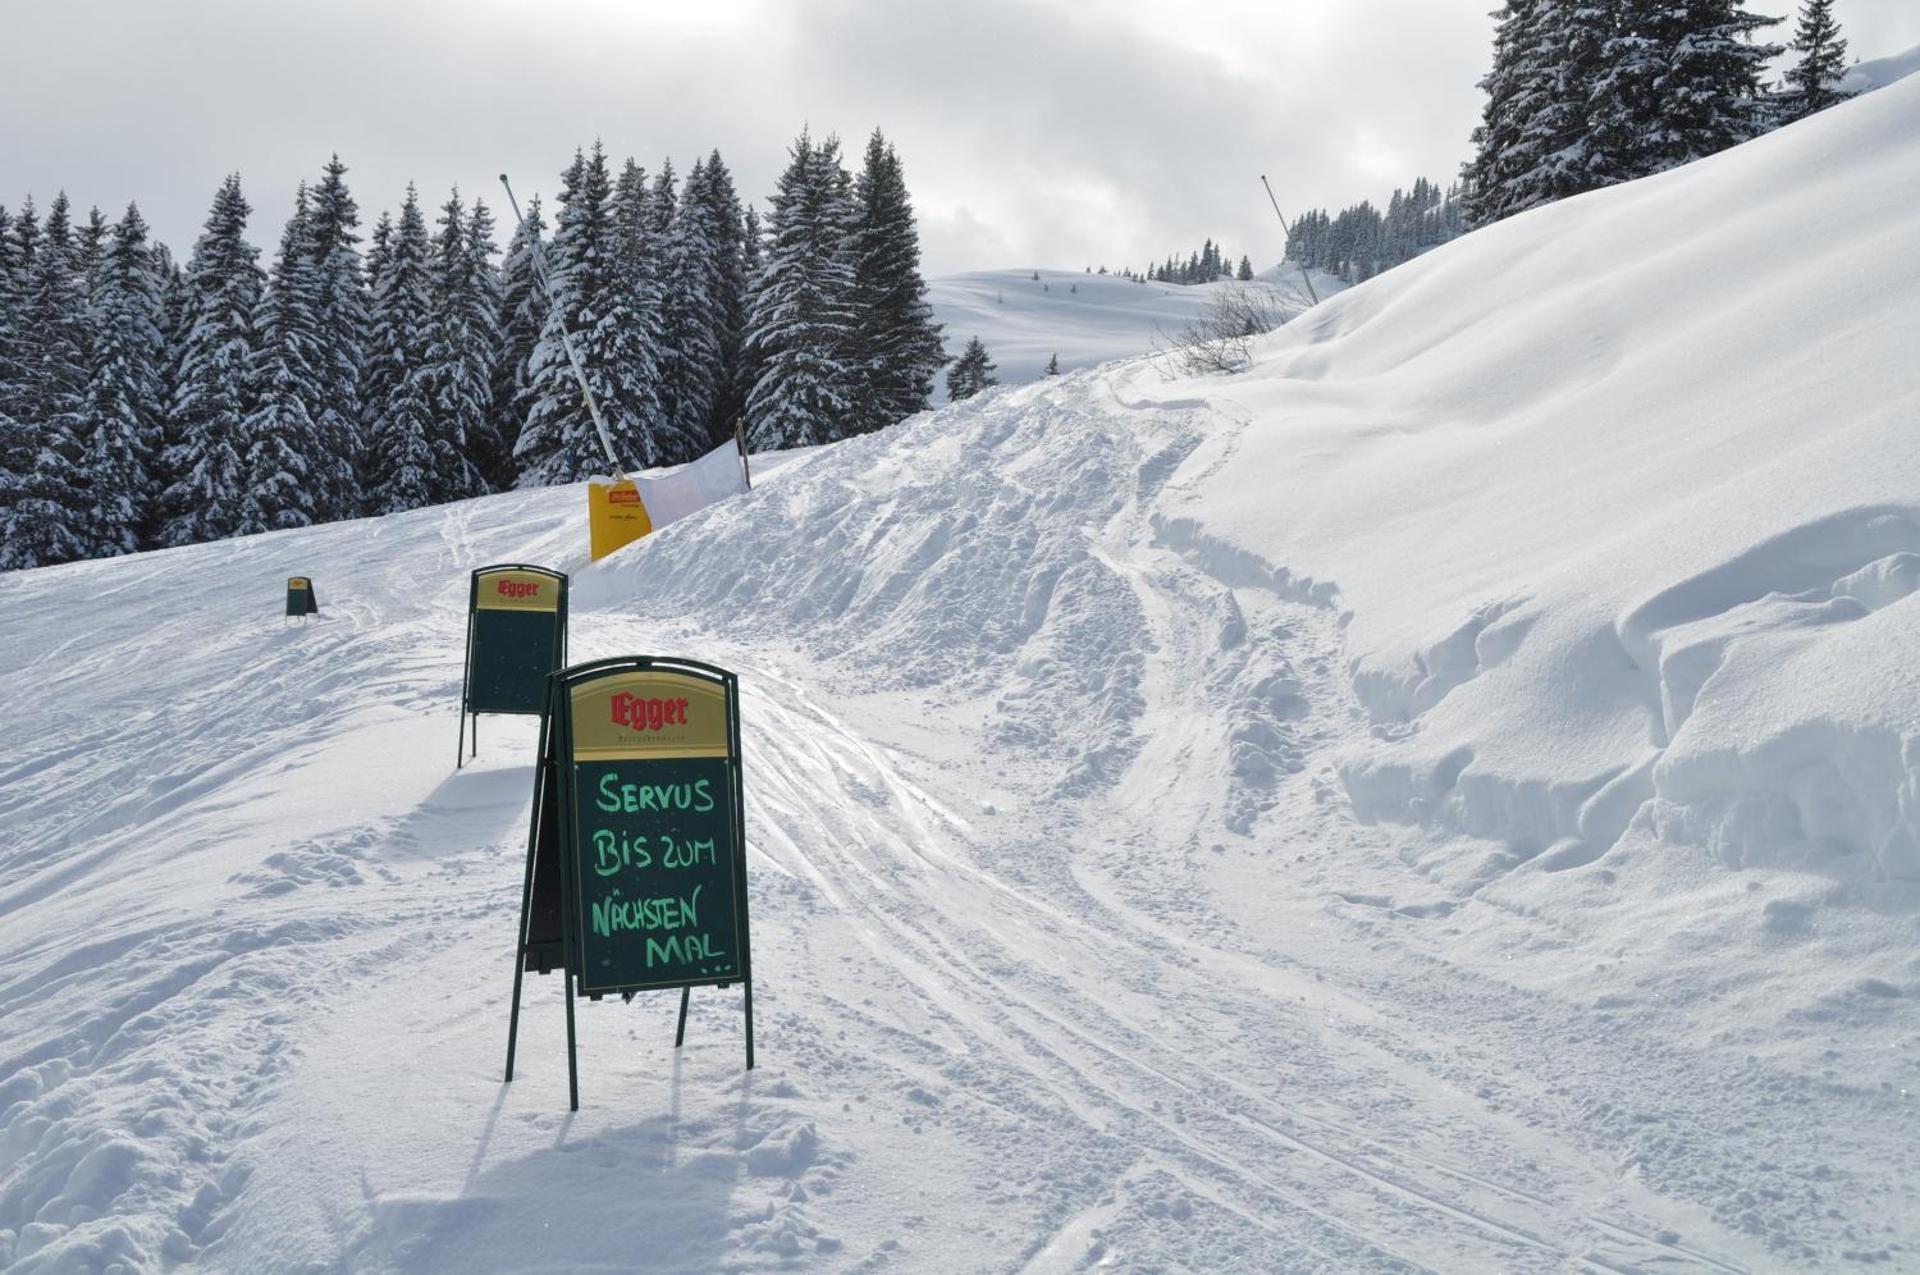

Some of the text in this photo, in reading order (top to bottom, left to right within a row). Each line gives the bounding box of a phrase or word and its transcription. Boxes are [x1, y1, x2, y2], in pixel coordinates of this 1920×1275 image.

[498, 579, 540, 598] Egger
[610, 691, 689, 732] Egger
[596, 773, 714, 813] SERVUS
[592, 884, 702, 938] NÄCHSTEN
